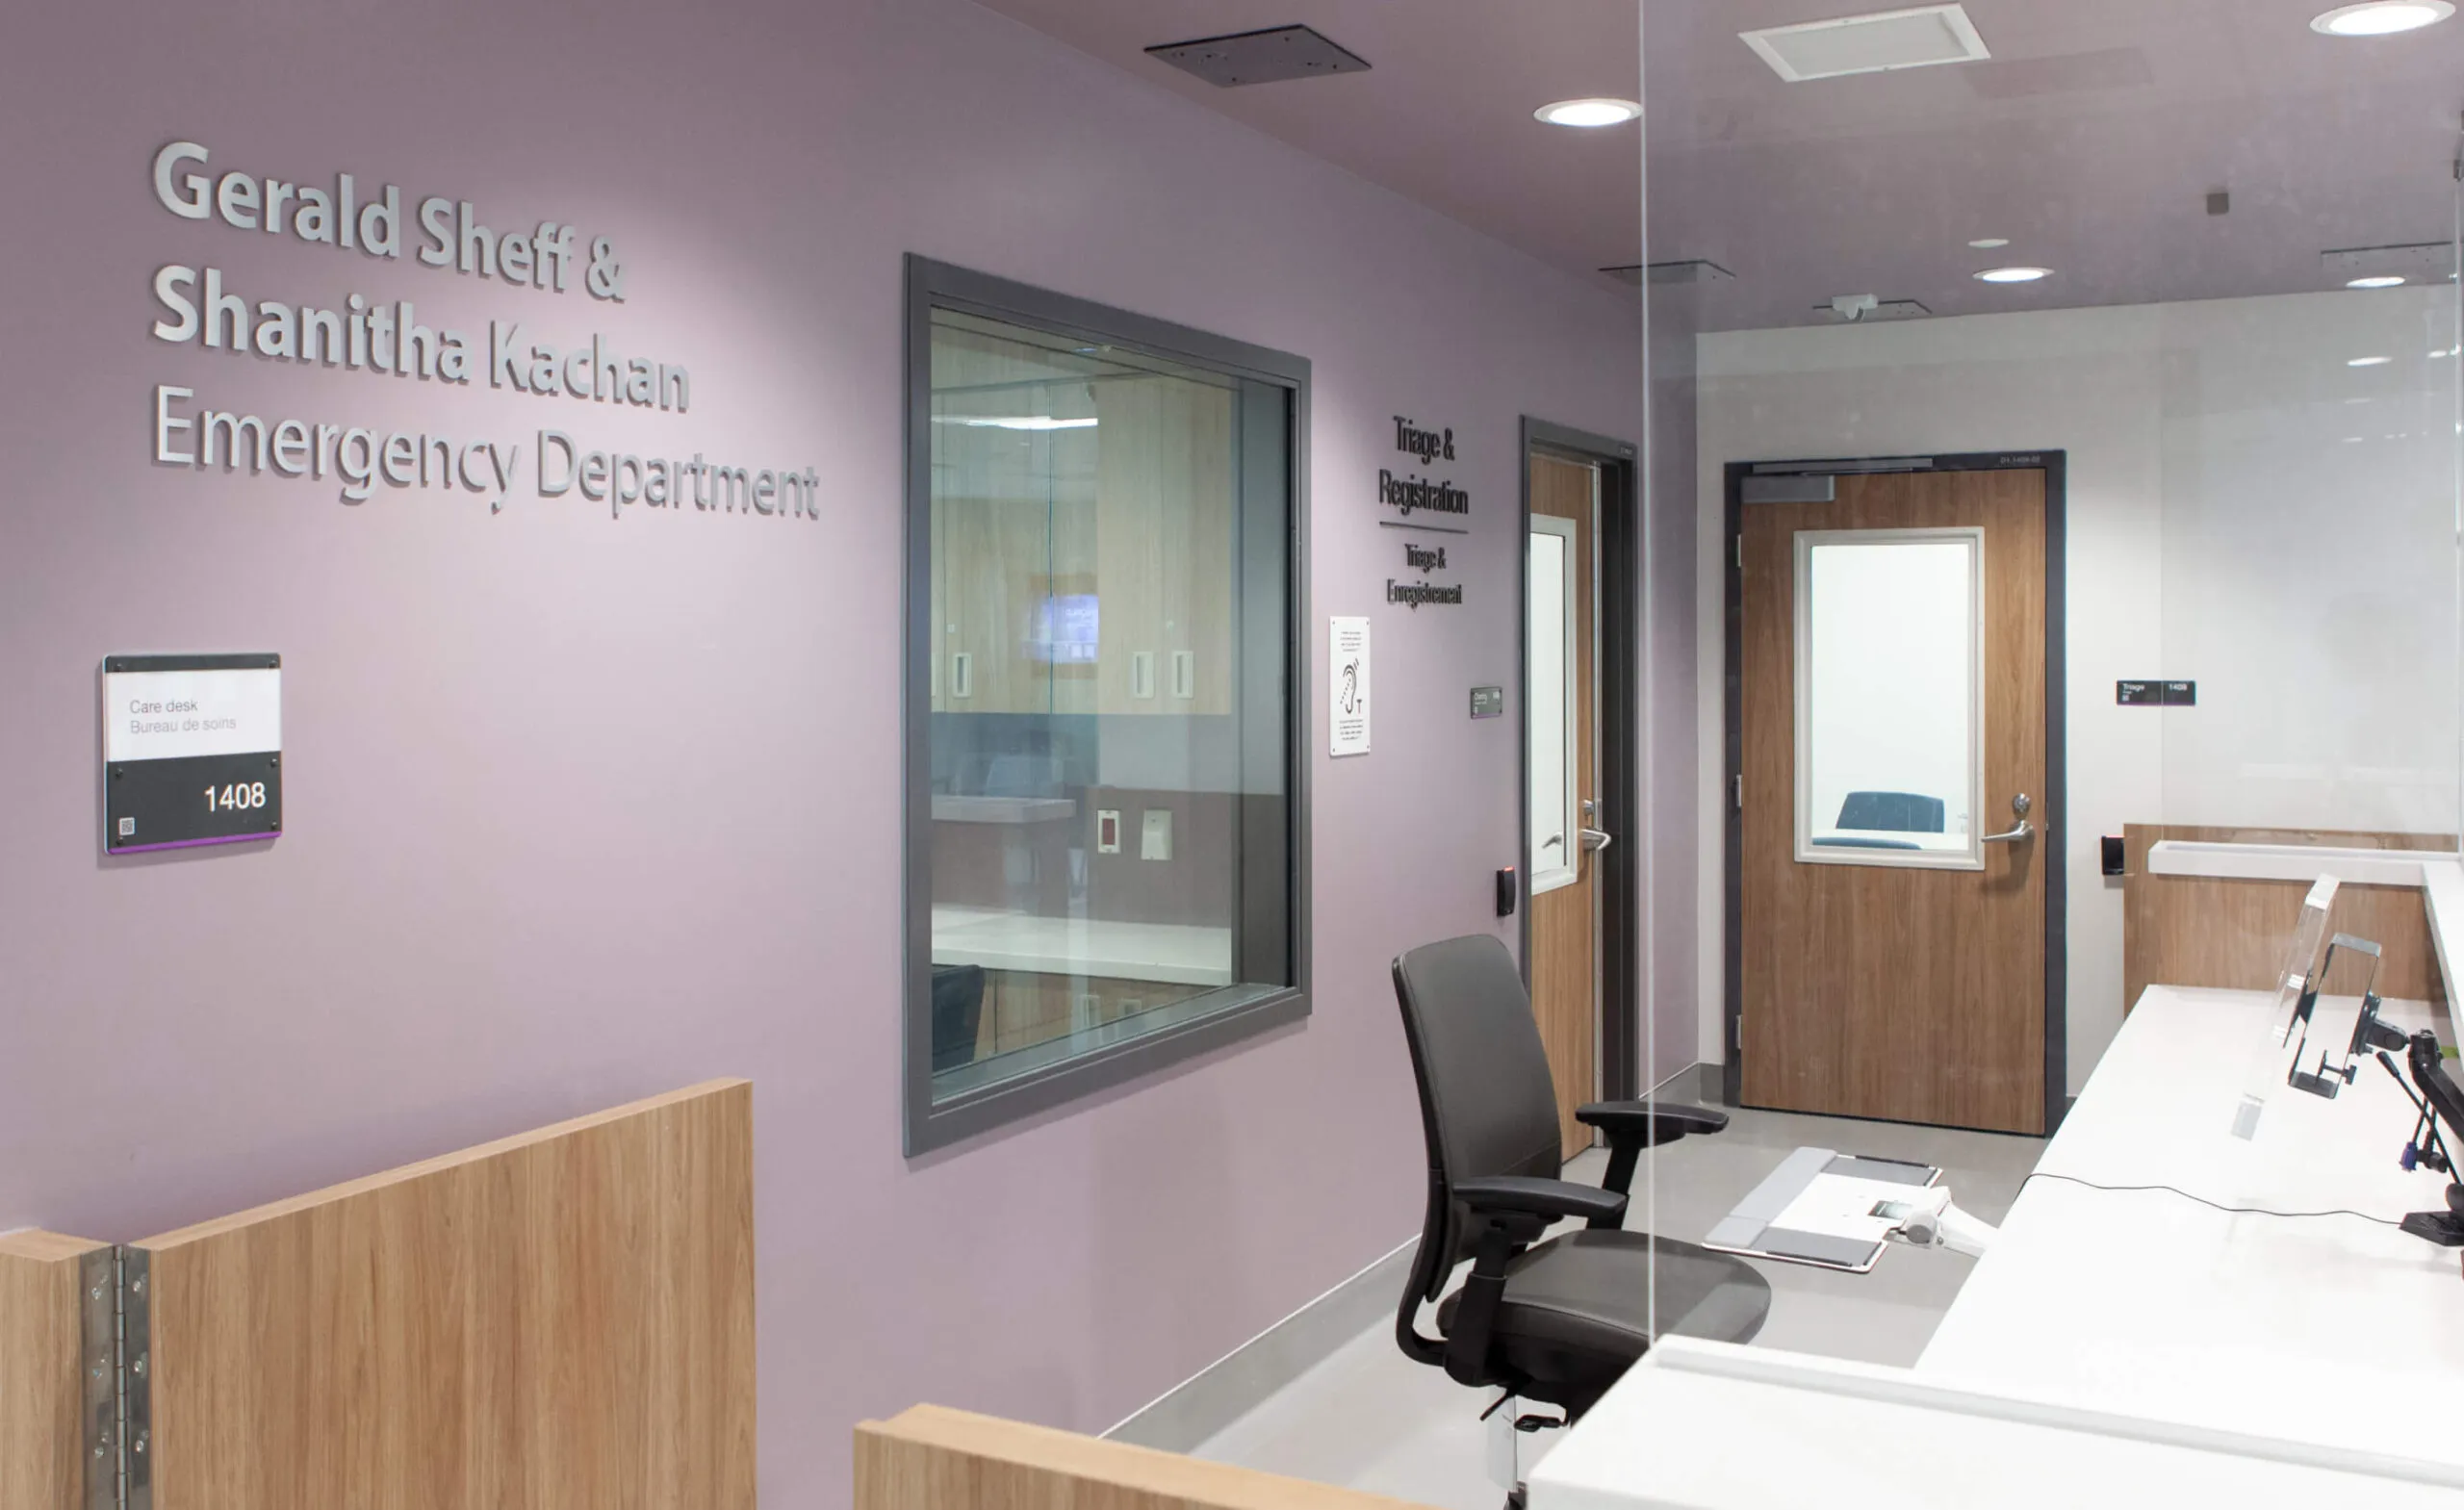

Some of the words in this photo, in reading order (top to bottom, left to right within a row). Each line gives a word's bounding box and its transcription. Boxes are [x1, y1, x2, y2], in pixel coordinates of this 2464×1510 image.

[153, 141, 400, 259] Gerald
[418, 196, 575, 293] Sheff
[587, 235, 627, 303] &
[153, 265, 472, 384] Shanitha
[489, 319, 690, 412] Kachan
[155, 385, 520, 512] Emergency
[537, 428, 819, 518] Department
[1393, 415, 1441, 466] Triage
[1443, 426, 1455, 462] &
[1378, 469, 1469, 516] Registration
[1404, 543, 1437, 575] Triage
[1437, 546, 1447, 570] &
[130, 700, 162, 714] Care
[166, 699, 198, 713] desk
[2122, 683, 2145, 692] Triage
[130, 719, 179, 734] Bureau
[182, 718, 199, 731] de
[202, 716, 237, 730] soins
[204, 781, 267, 812] 1408
